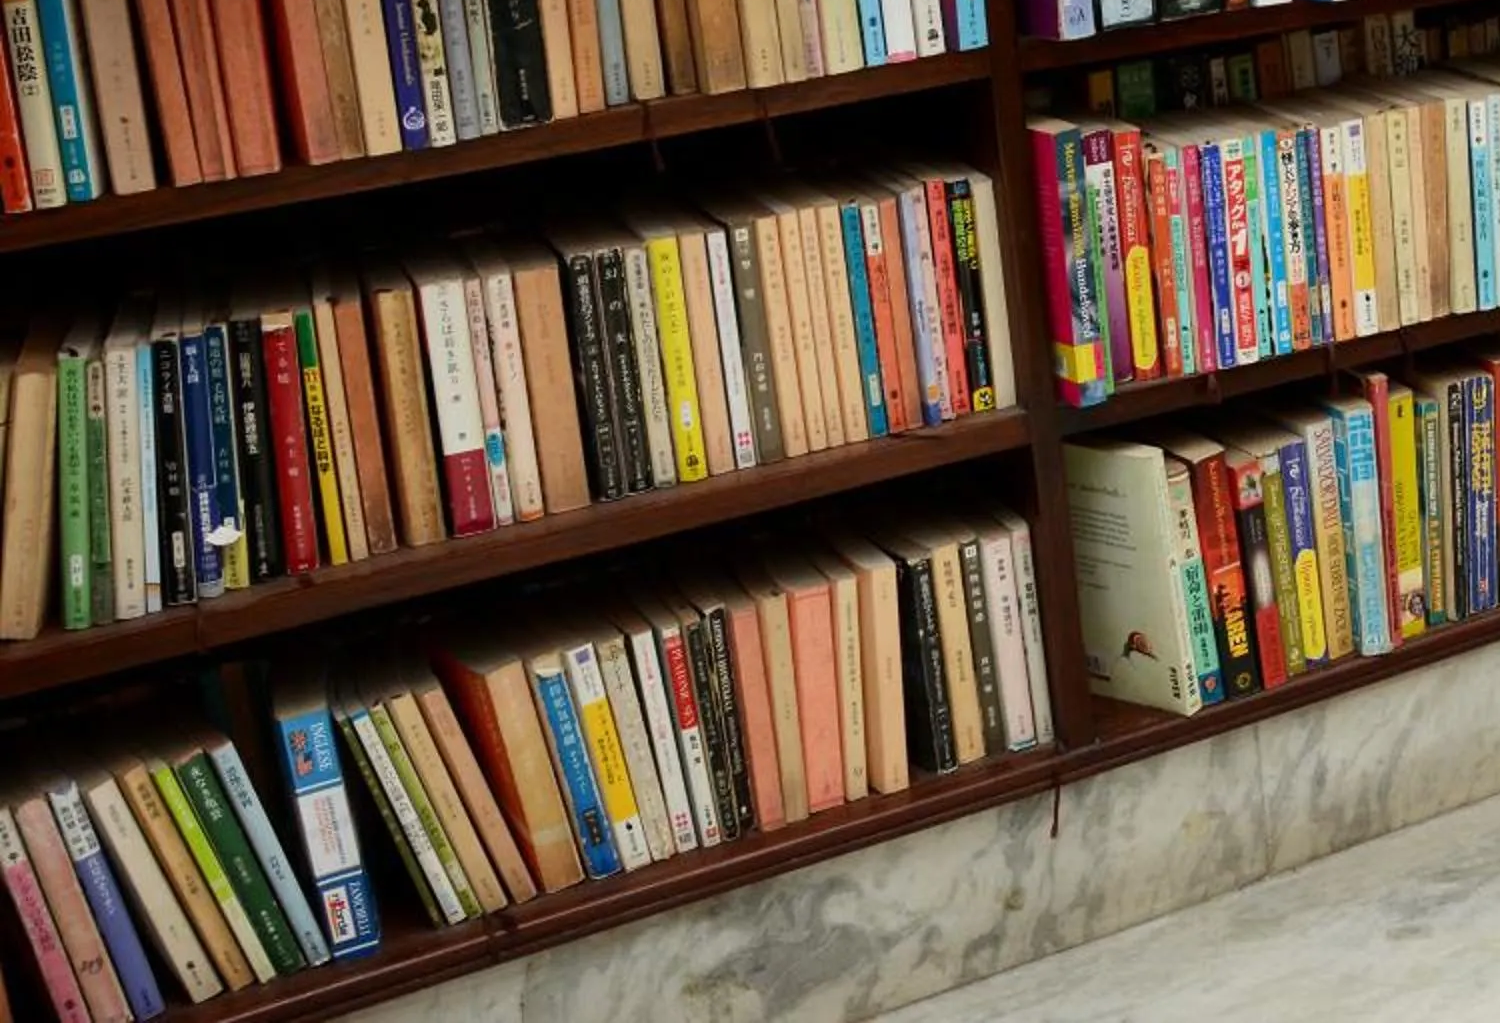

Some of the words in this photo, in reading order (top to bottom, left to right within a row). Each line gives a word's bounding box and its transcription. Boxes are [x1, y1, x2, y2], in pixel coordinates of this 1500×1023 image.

[1073, 258, 1096, 338] Hundehoved
[1313, 427, 1336, 497] SALVADOR
[309, 719, 333, 772] INGLESE
